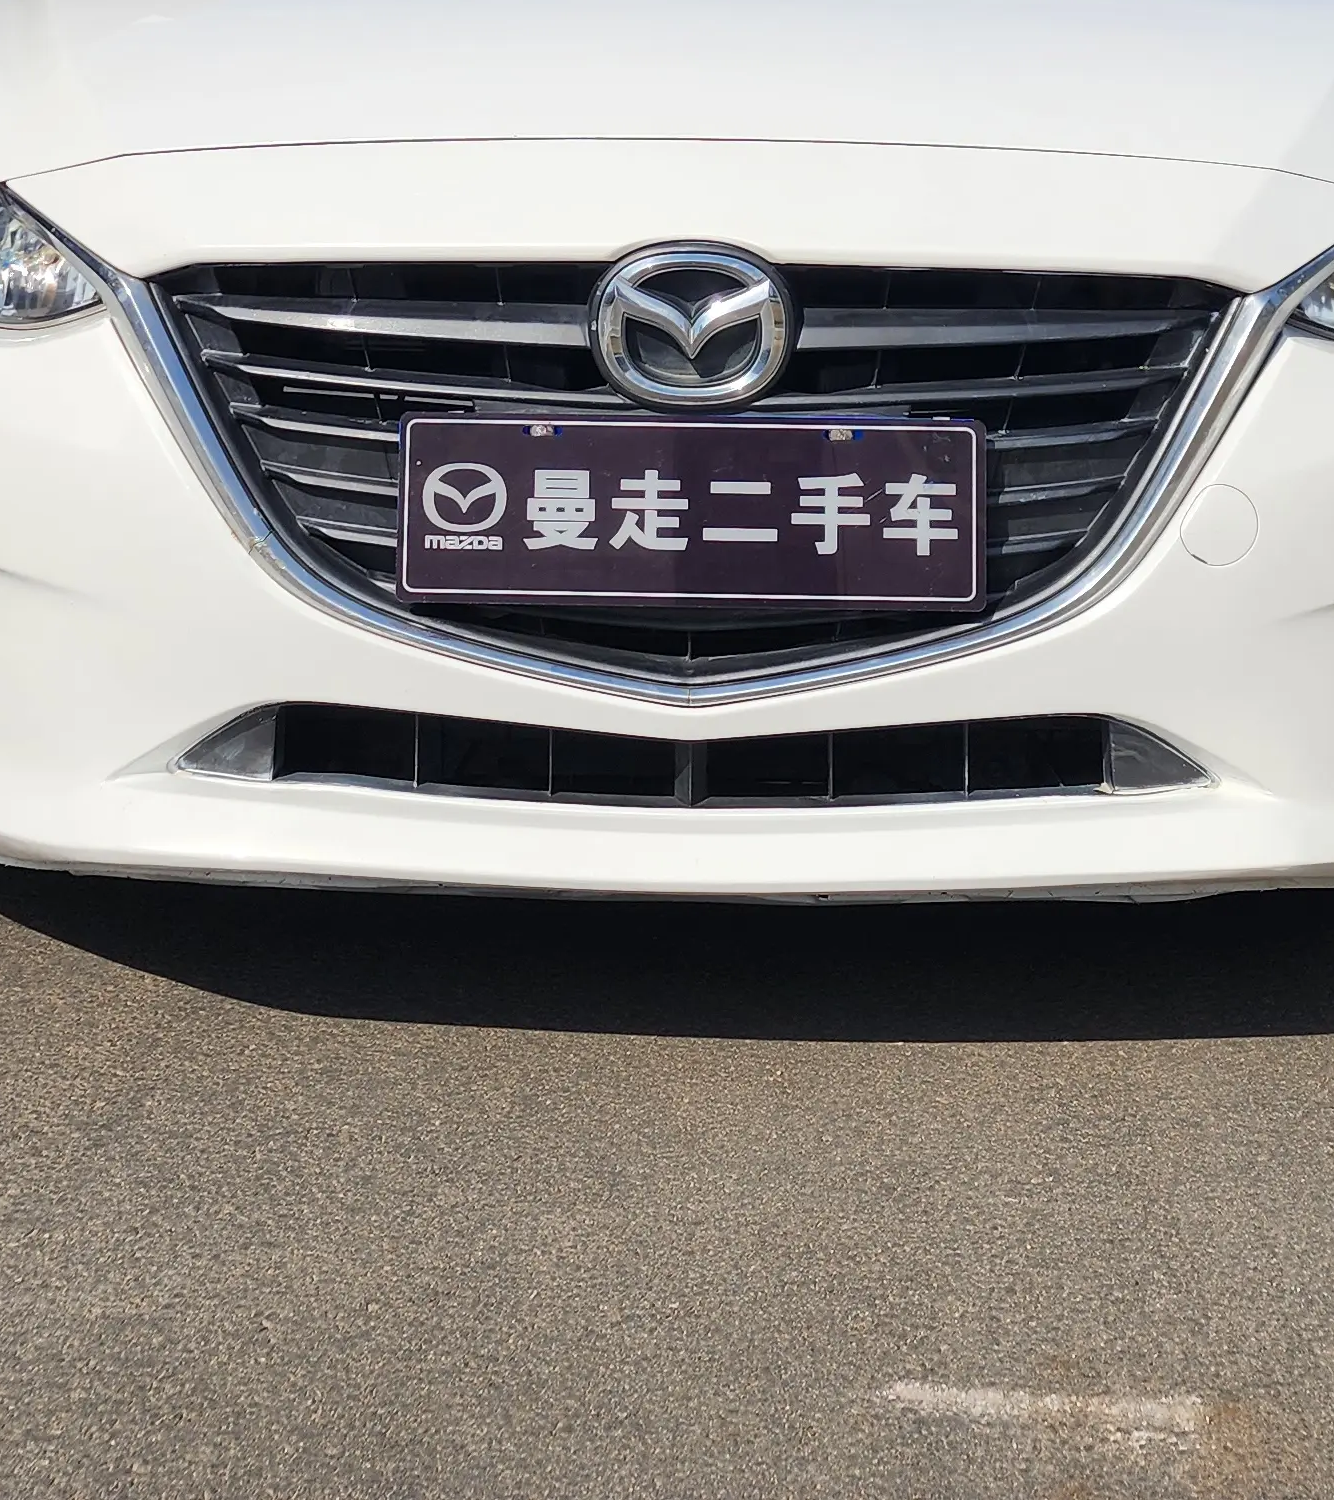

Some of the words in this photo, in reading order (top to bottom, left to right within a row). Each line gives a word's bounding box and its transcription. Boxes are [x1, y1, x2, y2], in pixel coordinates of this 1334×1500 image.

[522, 469, 960, 557] 曼走二手车
